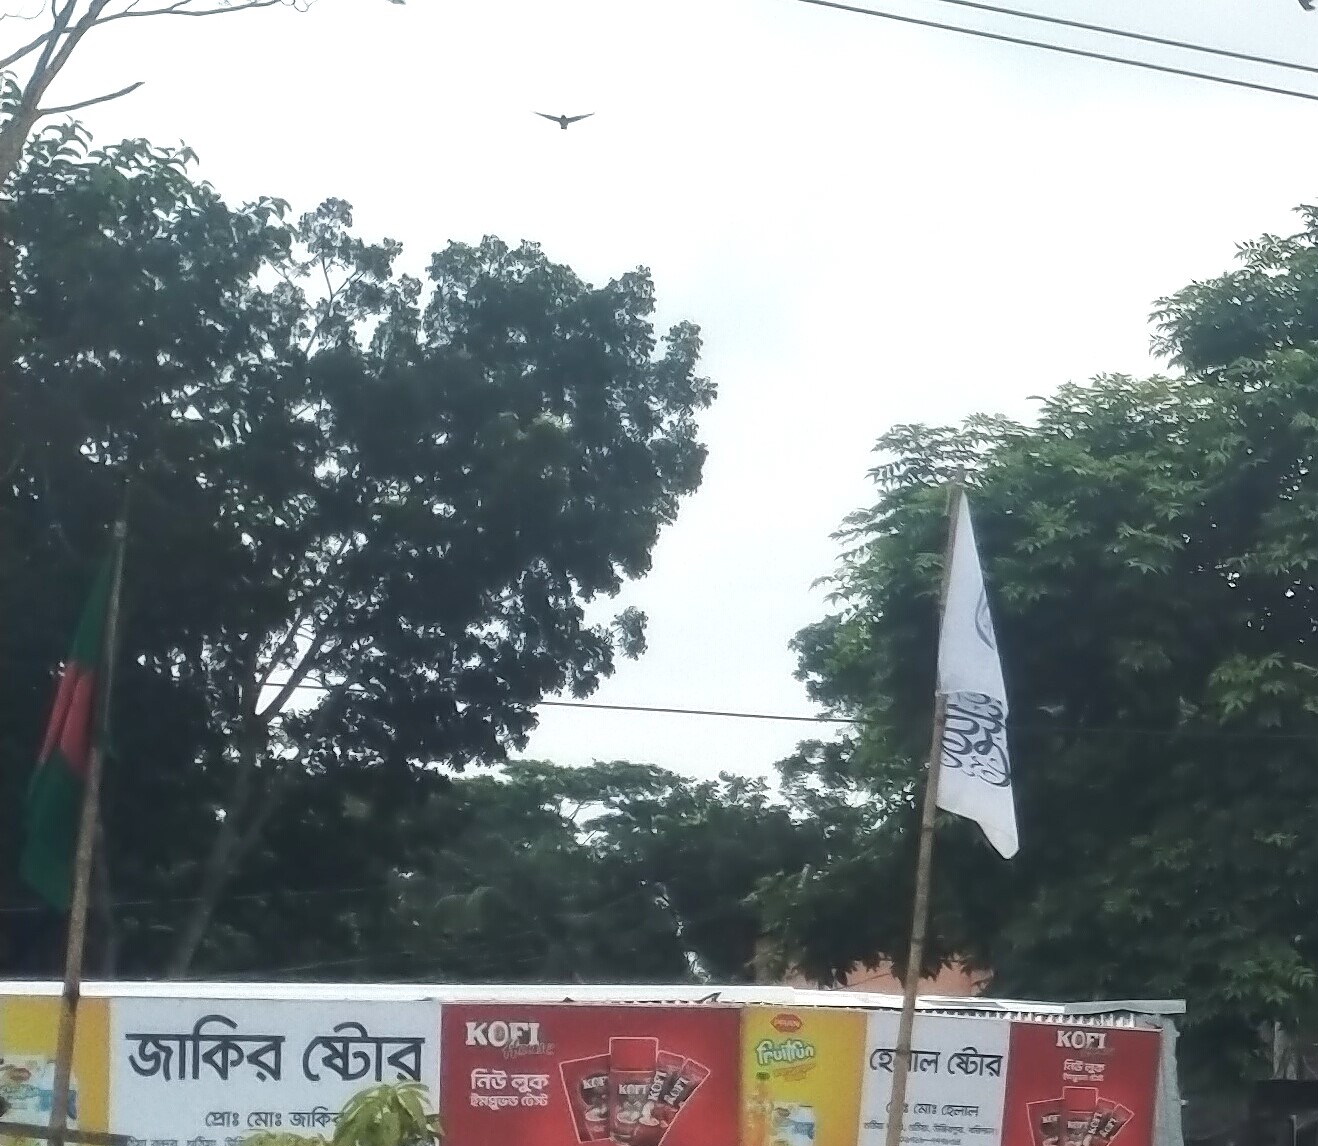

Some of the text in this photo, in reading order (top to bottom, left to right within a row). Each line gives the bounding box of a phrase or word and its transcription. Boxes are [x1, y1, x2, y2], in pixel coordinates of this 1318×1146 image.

[465, 1020, 540, 1047] KOFI
[1056, 1030, 1107, 1049] KOFI
[125, 1014, 426, 1083] জাকির ষ্টোর
[869, 1048, 941, 1074] হোল
[471, 1067, 550, 1093] নিউ লুক
[205, 1110, 241, 1128] প্রোঃ
[247, 1110, 283, 1128] মোঃ
